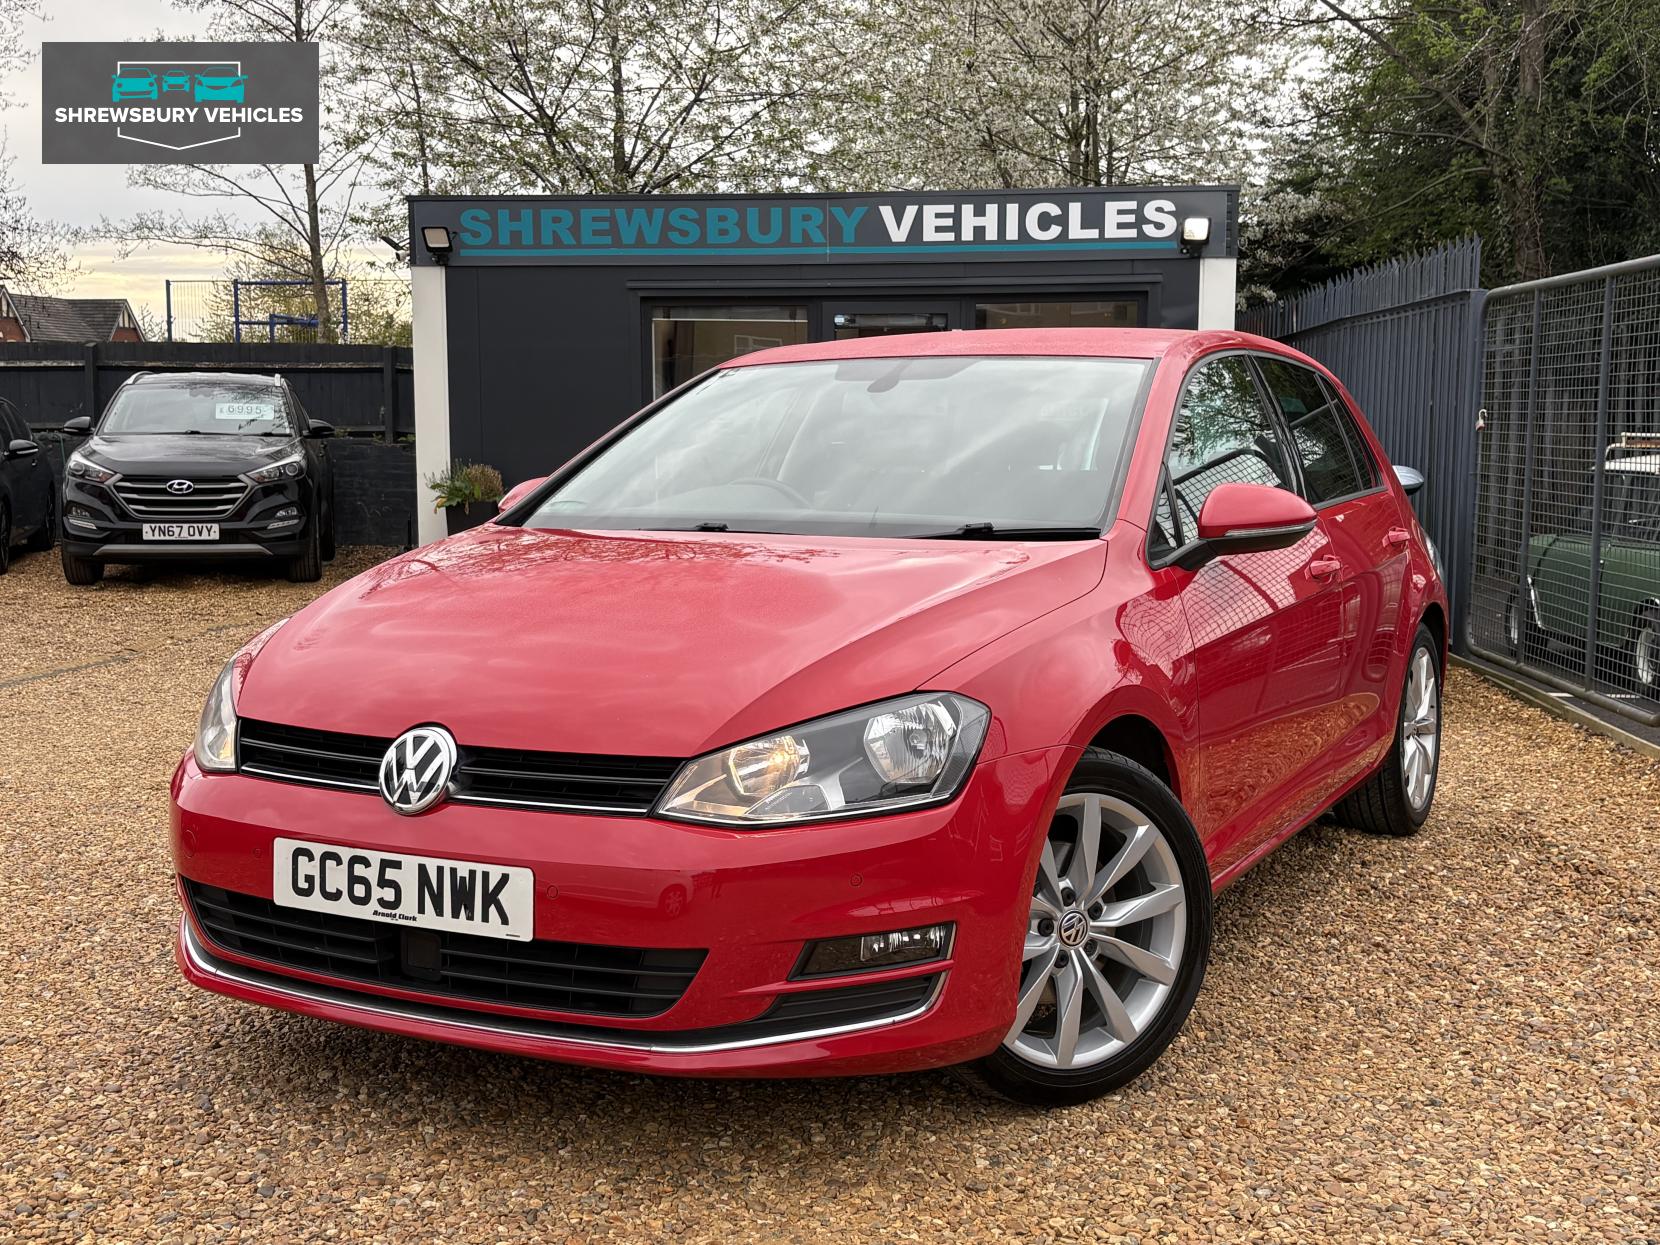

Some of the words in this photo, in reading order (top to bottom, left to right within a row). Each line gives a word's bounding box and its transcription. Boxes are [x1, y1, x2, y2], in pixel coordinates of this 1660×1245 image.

[460, 205, 868, 247] SHREWSBURY
[878, 199, 1177, 244] VEHICLES
[149, 524, 184, 537] YN67
[187, 524, 213, 537] OVY
[291, 846, 403, 911] GC65
[417, 863, 510, 926] NWK
[372, 910, 397, 919] Arnold
[398, 914, 418, 922] Clark
